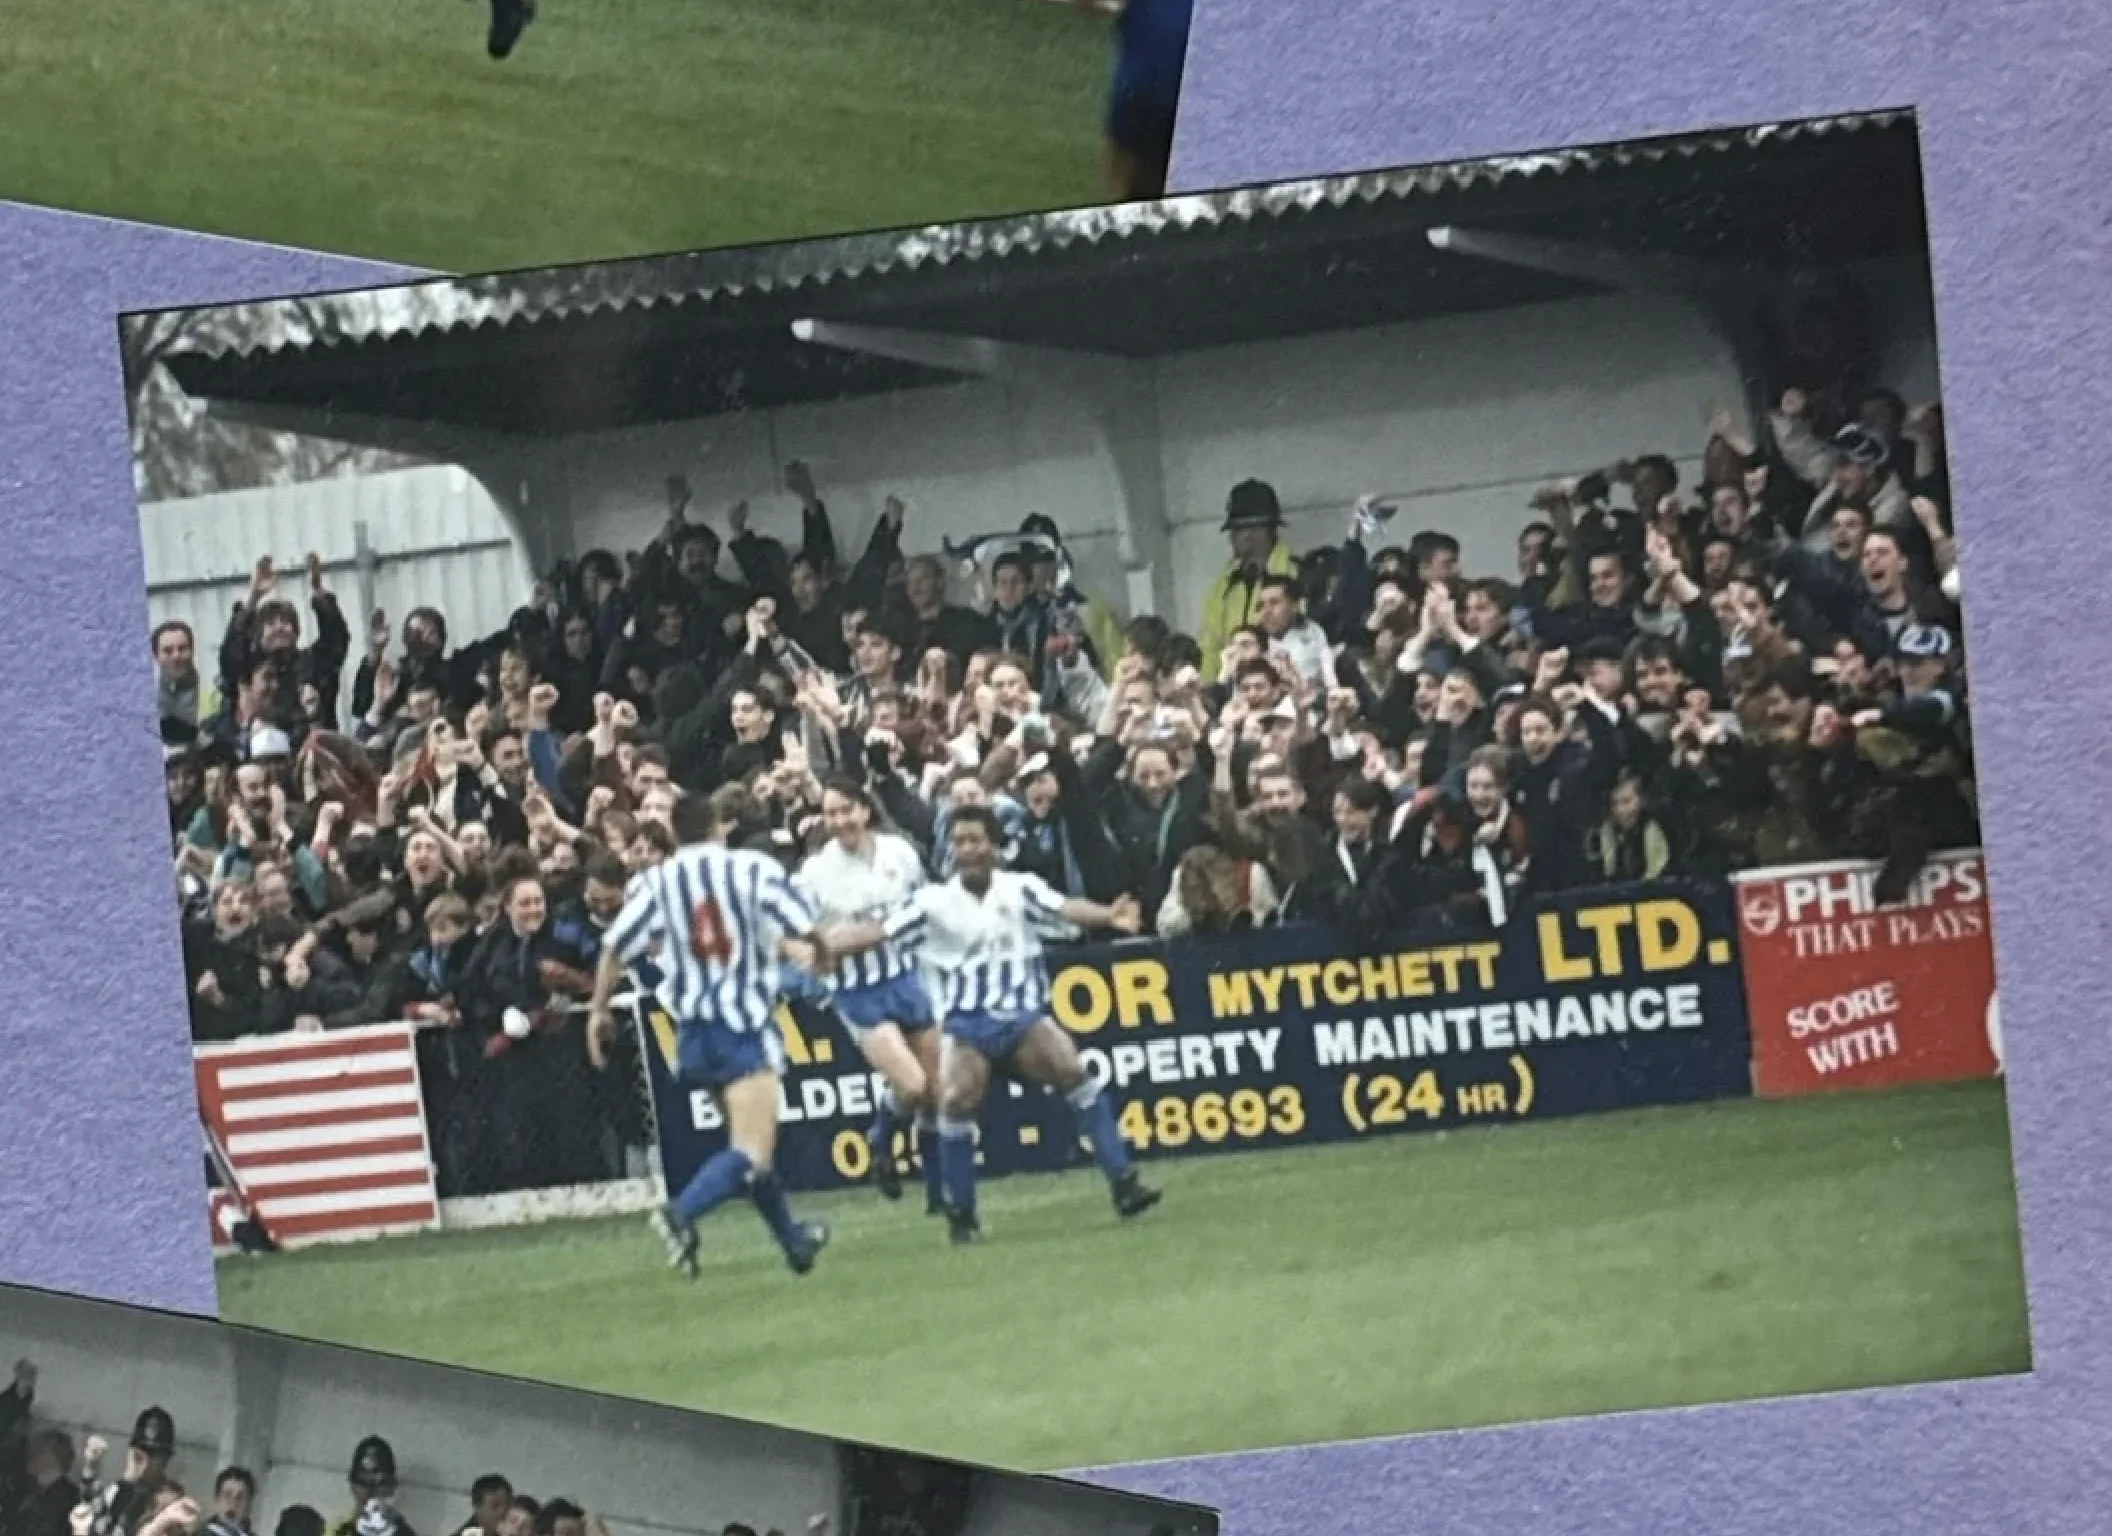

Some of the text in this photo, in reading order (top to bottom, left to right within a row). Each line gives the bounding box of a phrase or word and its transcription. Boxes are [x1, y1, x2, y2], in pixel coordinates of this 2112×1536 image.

[1784, 860, 1982, 922] PHIIPS
[1786, 904, 1985, 957] THAT PLAYS
[1052, 899, 1731, 1033] OR MYTCHETT LTD.
[1786, 980, 1900, 1038] SCORE
[1008, 1026, 1282, 1098] OPERTY
[1313, 983, 1703, 1067] MAINTENANCE
[1807, 1021, 1899, 1076] WITH
[1079, 1085, 1306, 1151] 48693
